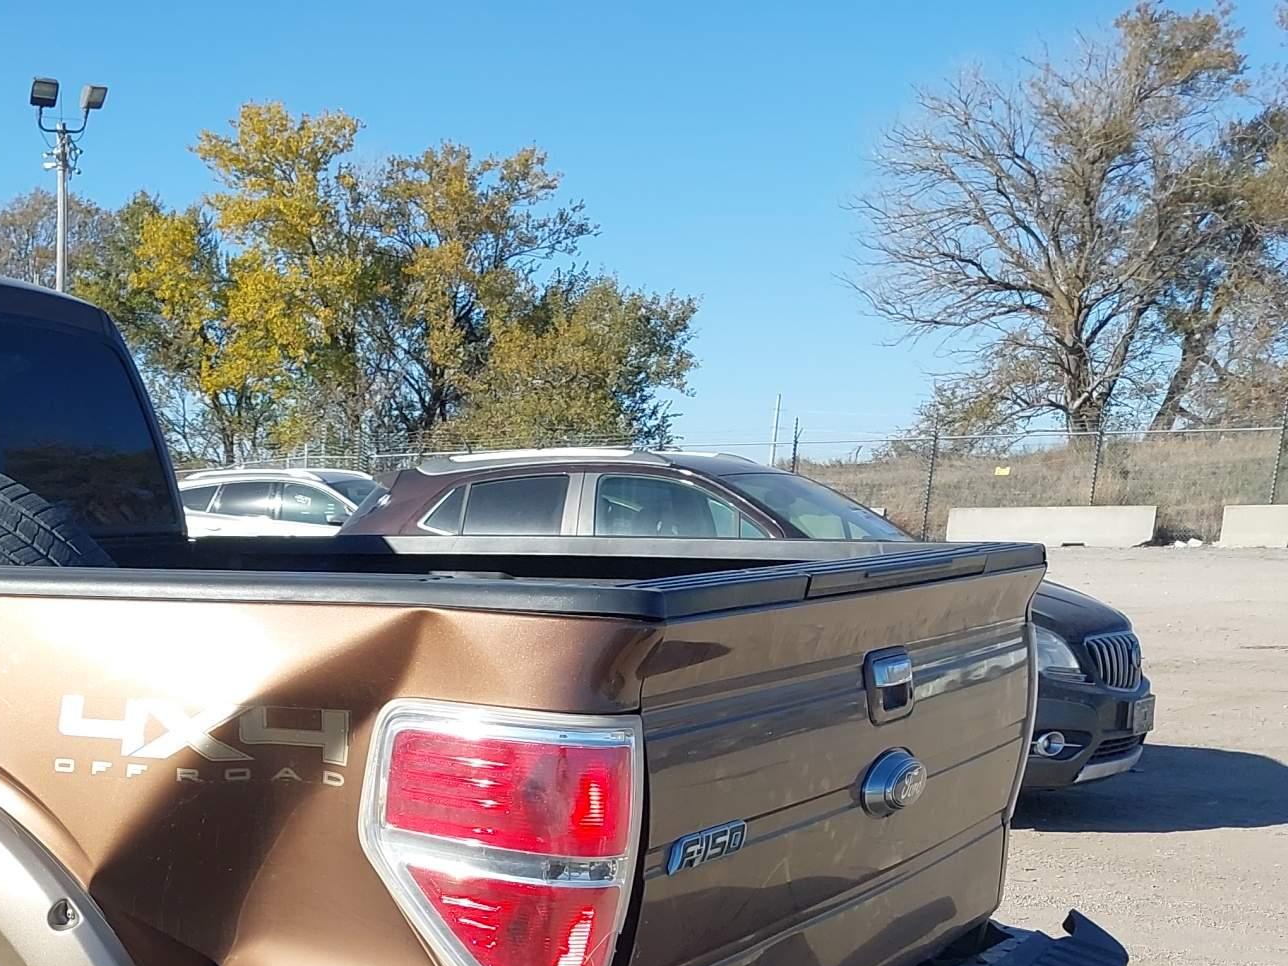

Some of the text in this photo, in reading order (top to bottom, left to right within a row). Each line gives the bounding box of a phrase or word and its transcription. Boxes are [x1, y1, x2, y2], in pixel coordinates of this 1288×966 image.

[54, 758, 345, 787] OFF ROAD
[900, 768, 926, 800] Ford
[671, 820, 747, 874] F-150
